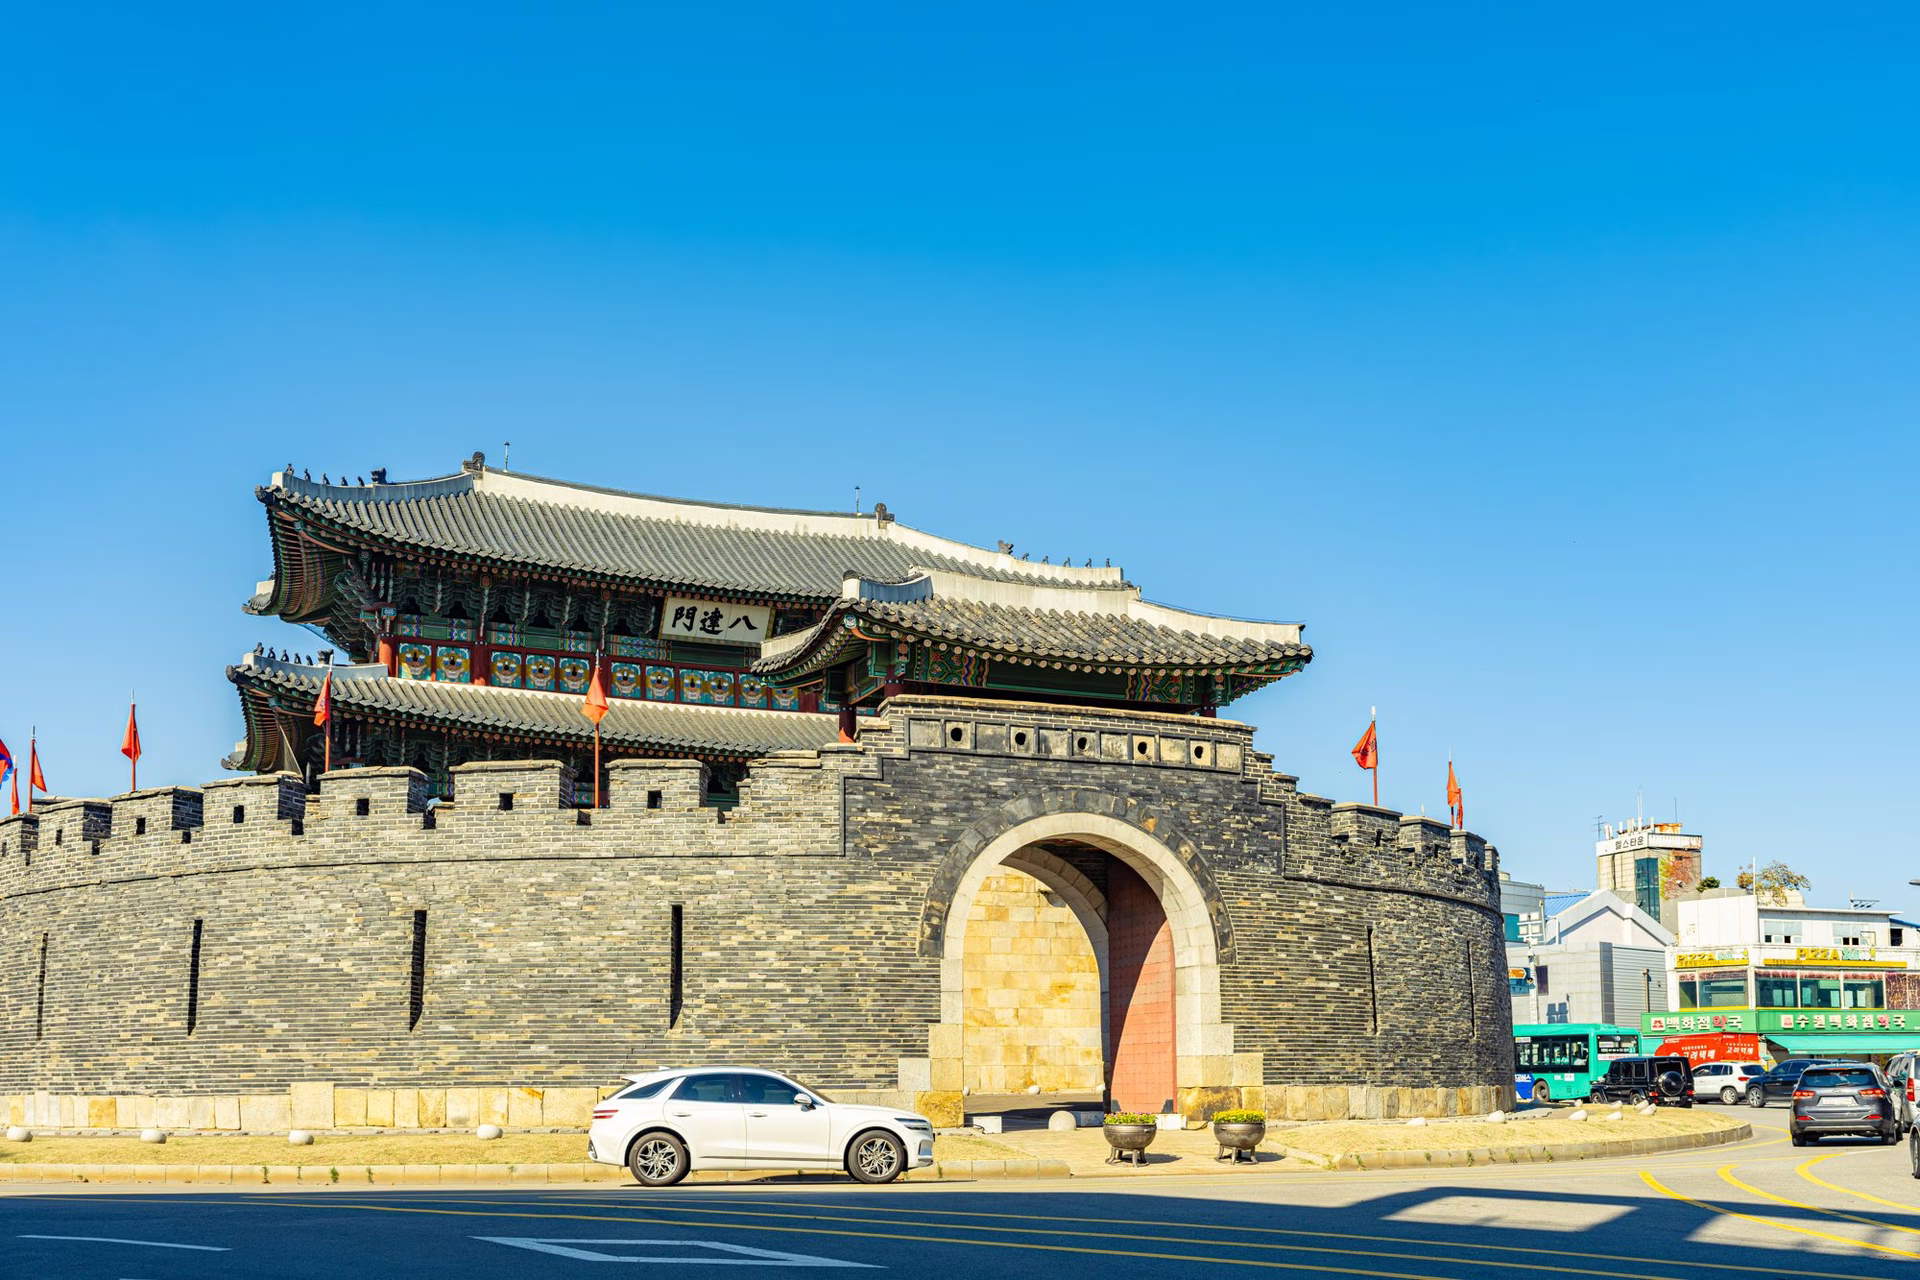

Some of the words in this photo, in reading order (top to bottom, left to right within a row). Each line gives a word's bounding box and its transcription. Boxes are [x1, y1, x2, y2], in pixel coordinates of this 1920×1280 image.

[1676, 953, 1715, 962] PIZZA
[1796, 948, 1840, 960] PIZZA
[1666, 1015, 1742, 1030] 백화점약국
[1796, 1014, 1906, 1029] 수원백화점약국
